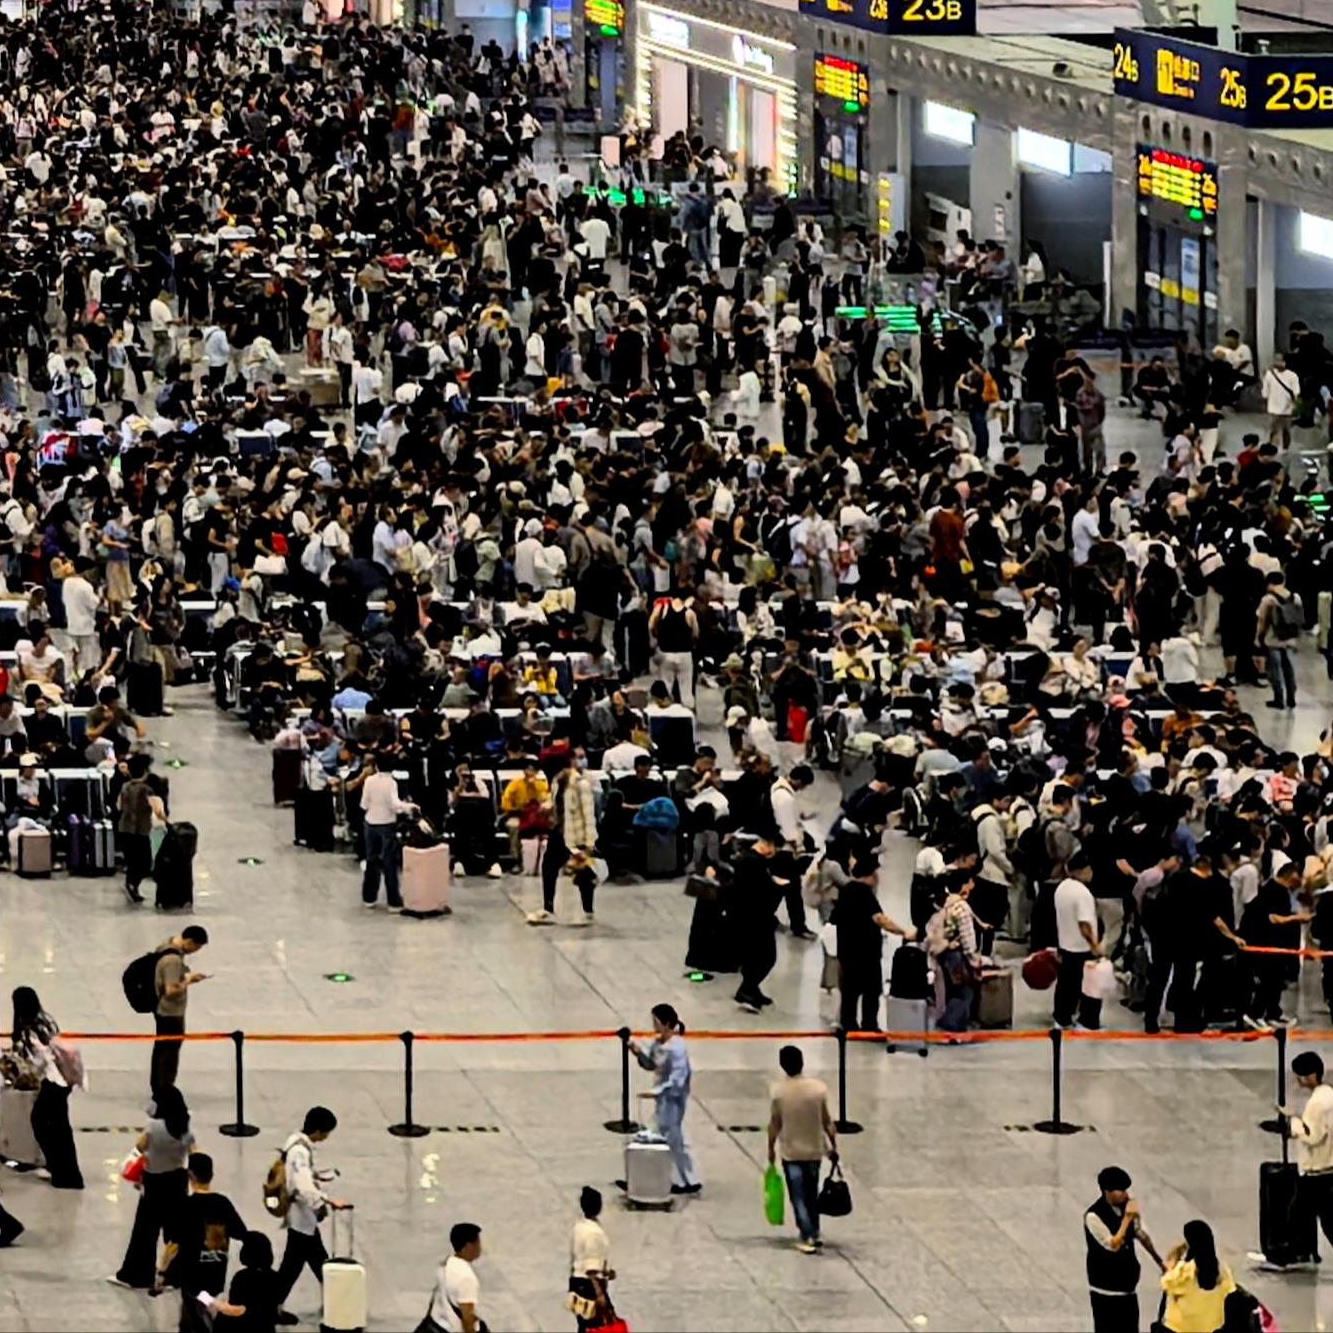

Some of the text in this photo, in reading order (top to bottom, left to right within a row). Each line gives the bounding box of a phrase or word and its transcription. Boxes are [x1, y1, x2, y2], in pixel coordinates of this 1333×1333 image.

[1114, 43, 1139, 82] 24B
[1220, 67, 1247, 108] 25B
[1265, 72, 1333, 111] 25B
